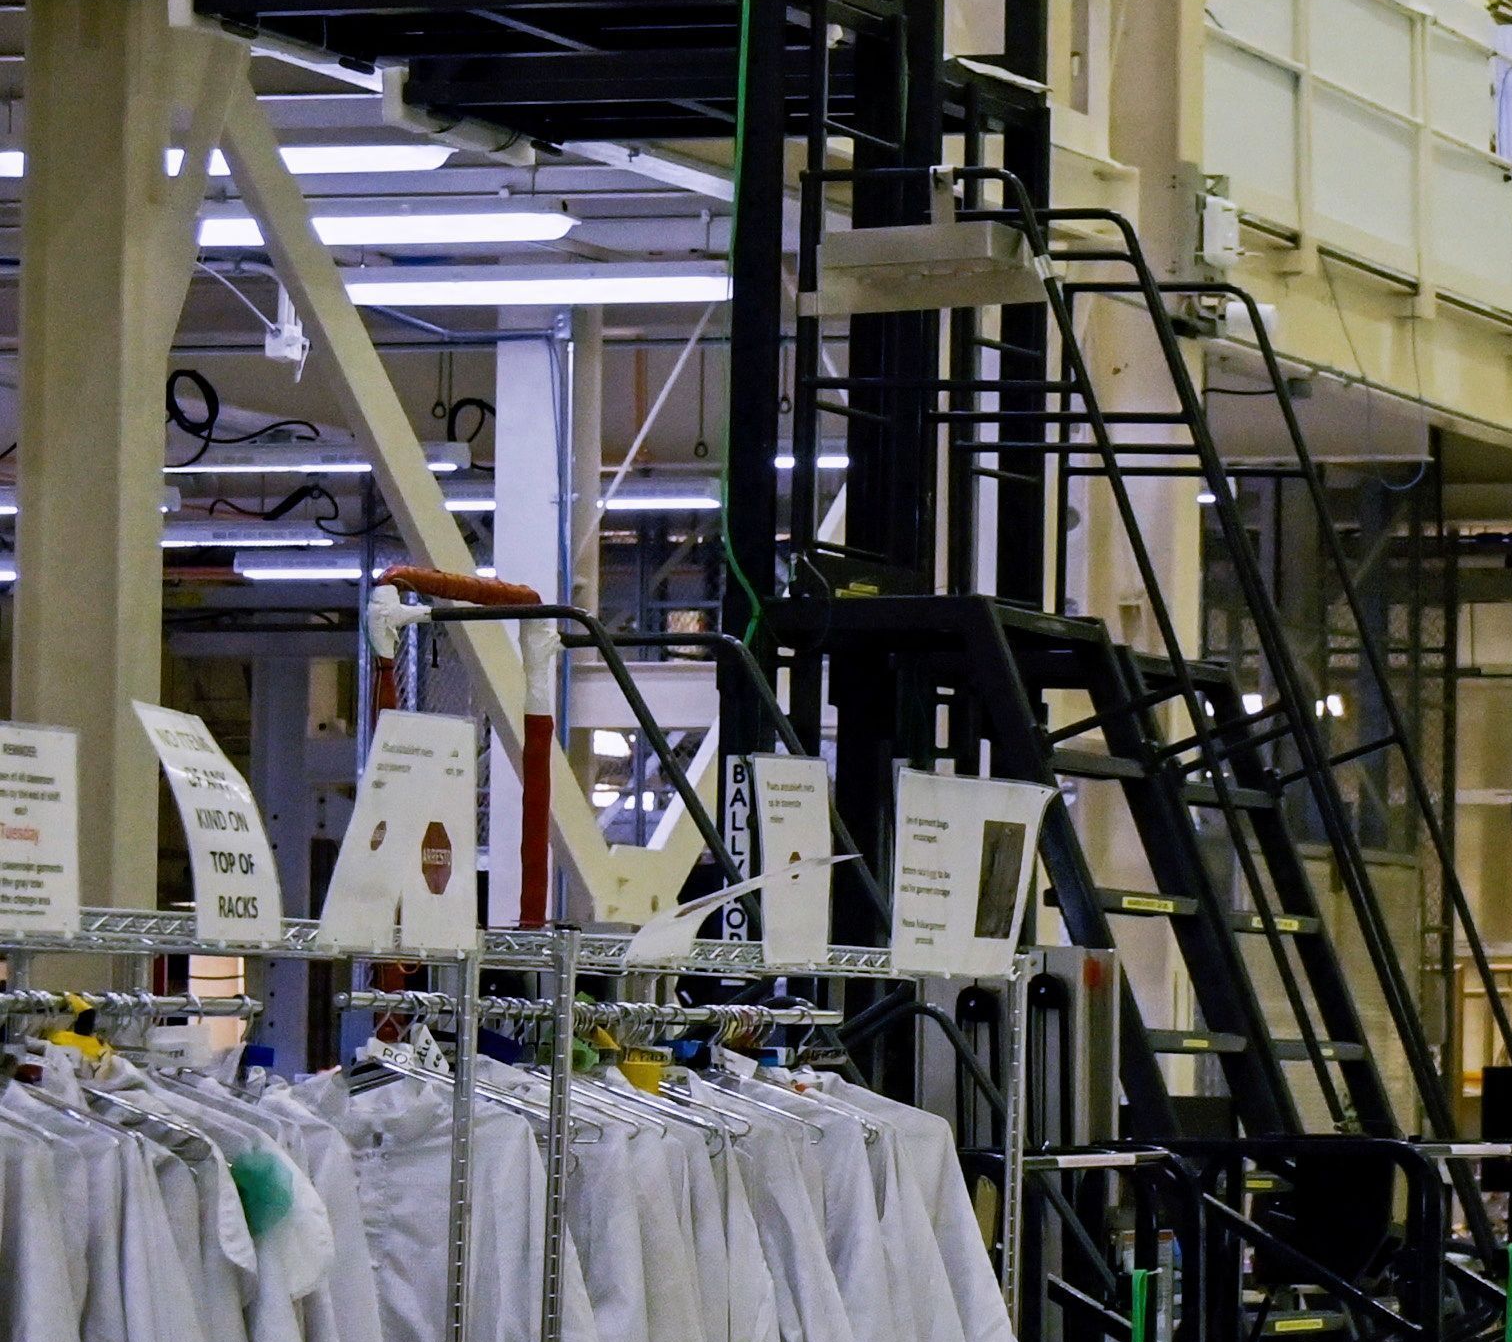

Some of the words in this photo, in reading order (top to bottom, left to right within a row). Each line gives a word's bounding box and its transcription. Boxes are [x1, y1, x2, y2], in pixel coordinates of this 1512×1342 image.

[195, 807, 227, 831] KIND
[229, 811, 250, 833] ON
[209, 850, 236, 874] TOP
[239, 853, 256, 875] OF
[218, 895, 259, 919] RACKS
